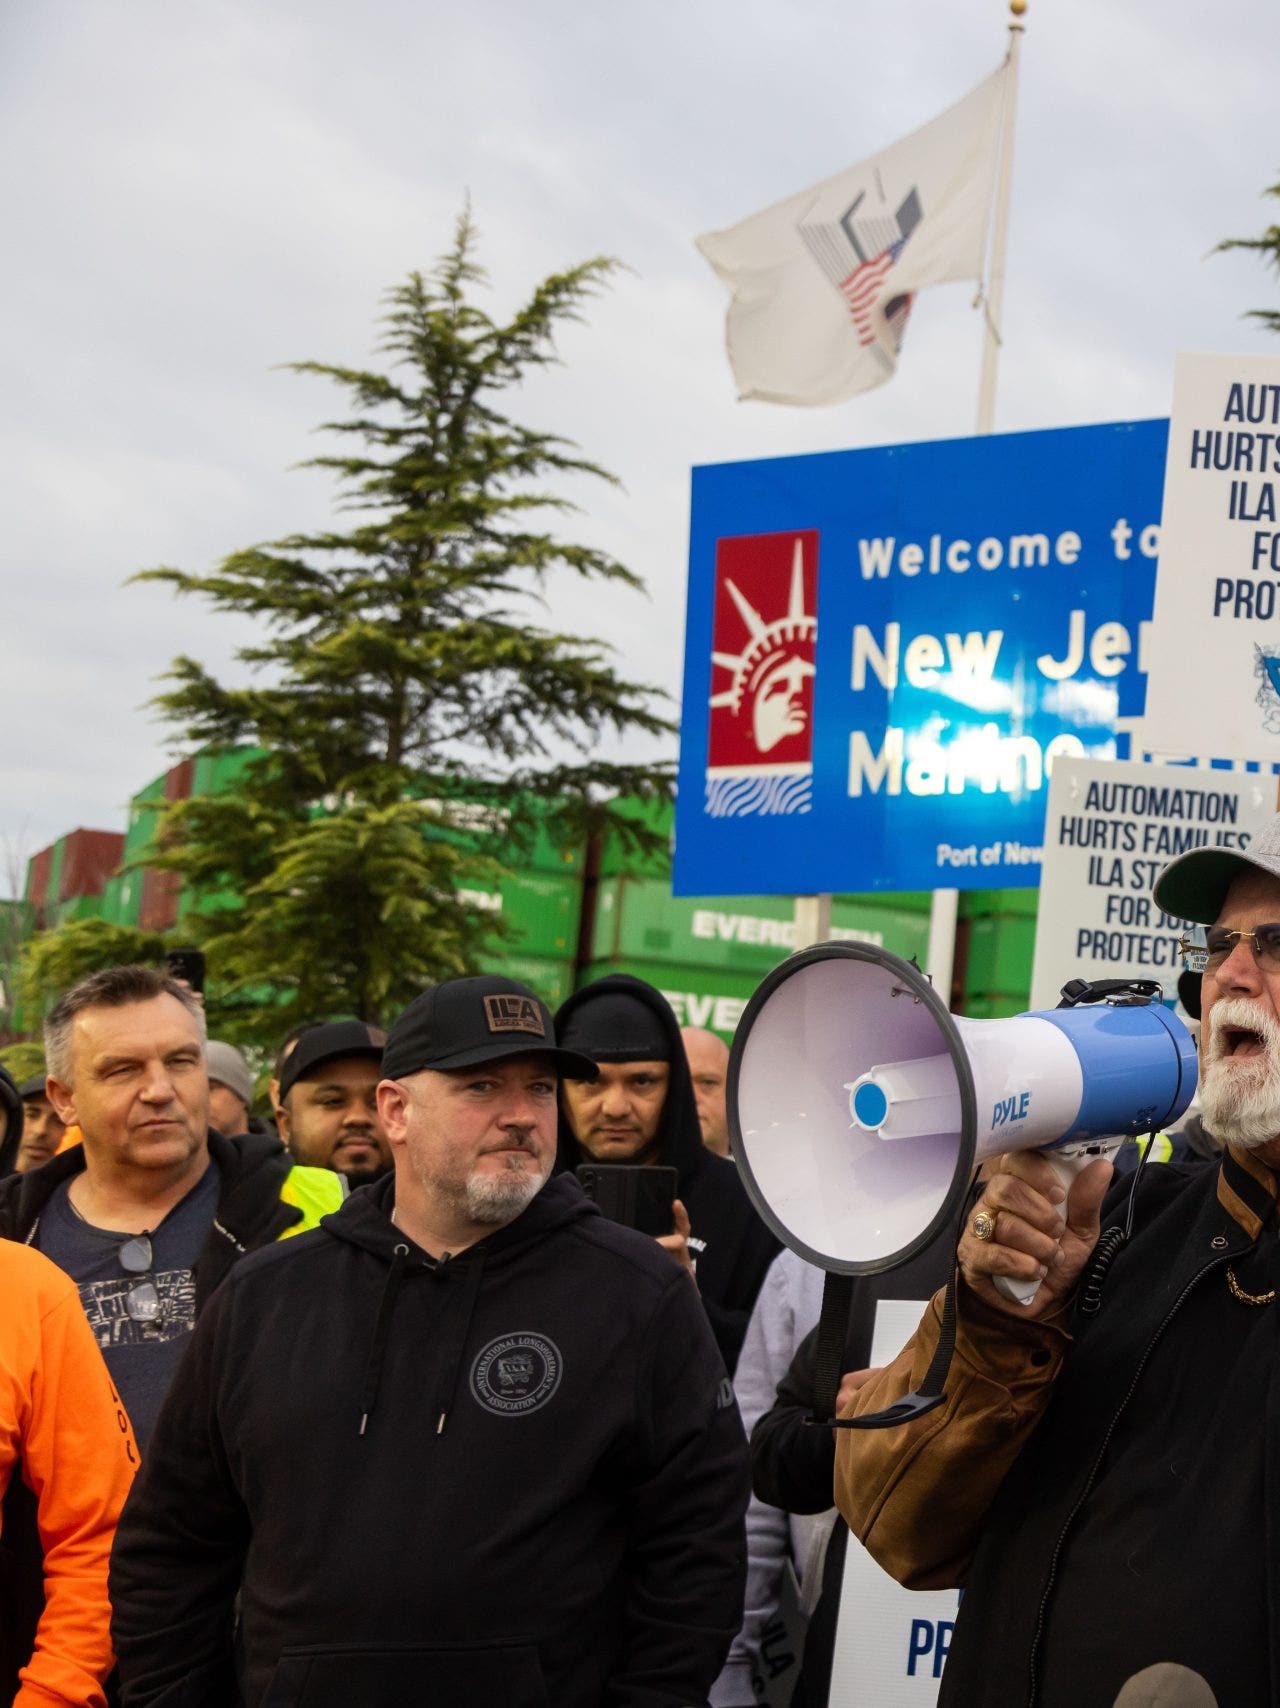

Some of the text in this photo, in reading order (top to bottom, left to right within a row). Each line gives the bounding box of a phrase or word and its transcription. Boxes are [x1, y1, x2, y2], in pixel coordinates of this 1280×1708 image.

[1228, 480, 1276, 522] ILA
[858, 518, 1161, 580] Welcome to
[850, 621, 1004, 692] New
[1085, 781, 1238, 824] AUTOMATION
[1059, 815, 1137, 851] HURTS
[936, 843, 977, 867] Port
[980, 841, 1002, 866] of
[1088, 855, 1169, 891] ILA ST
[1105, 895, 1150, 928] FOR
[1077, 928, 1187, 968] PROTECT
[489, 998, 540, 1022] ILA
[991, 1091, 1030, 1130] PYLE
